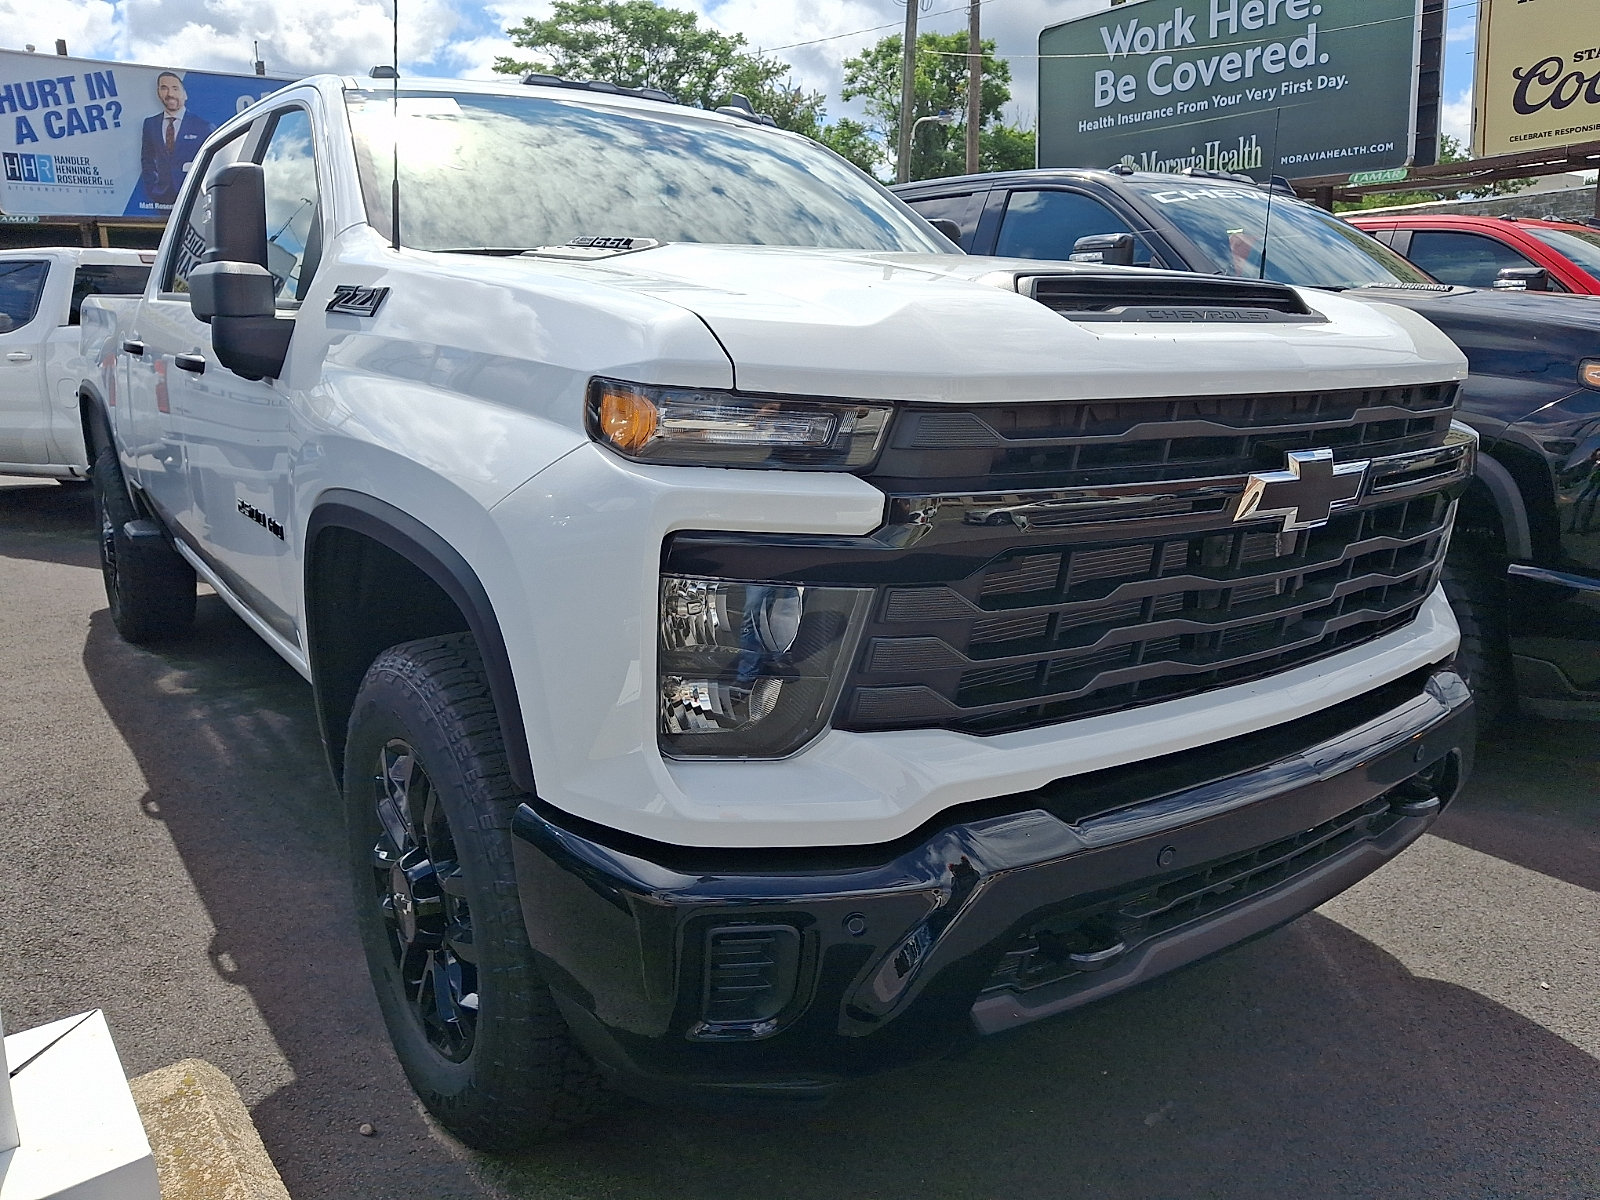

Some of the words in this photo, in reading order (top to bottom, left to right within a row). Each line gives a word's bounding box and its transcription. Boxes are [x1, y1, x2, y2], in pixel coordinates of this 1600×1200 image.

[1100, 7, 1196, 62] Work
[1209, 0, 1323, 38] Here.
[1094, 69, 1137, 108] Be
[1147, 23, 1329, 96] Covered.
[0, 75, 76, 114] HURT
[84, 70, 118, 101] IN
[1078, 117, 1115, 133] Health
[1117, 106, 1174, 126] Insurance
[1176, 100, 1209, 115] From
[1211, 94, 1243, 109] Your
[1246, 85, 1277, 104] Very
[1280, 80, 1313, 96] First
[1317, 74, 1349, 93] Day.
[16, 115, 39, 145] A
[43, 100, 122, 139] CAR?
[1509, 131, 1553, 143] CELEBRATE
[54, 155, 90, 166] HANDLER
[1280, 142, 1394, 165] MORAVIAHEALTH.COM
[5, 156, 53, 179] HHR
[56, 164, 91, 175] HENNING
[93, 166, 99, 176] &
[1353, 170, 1401, 183] LAMAR
[57, 174, 103, 186] ROSENBERG
[325, 284, 391, 317] Z71
[1146, 310, 1269, 320] CHEVROLET
